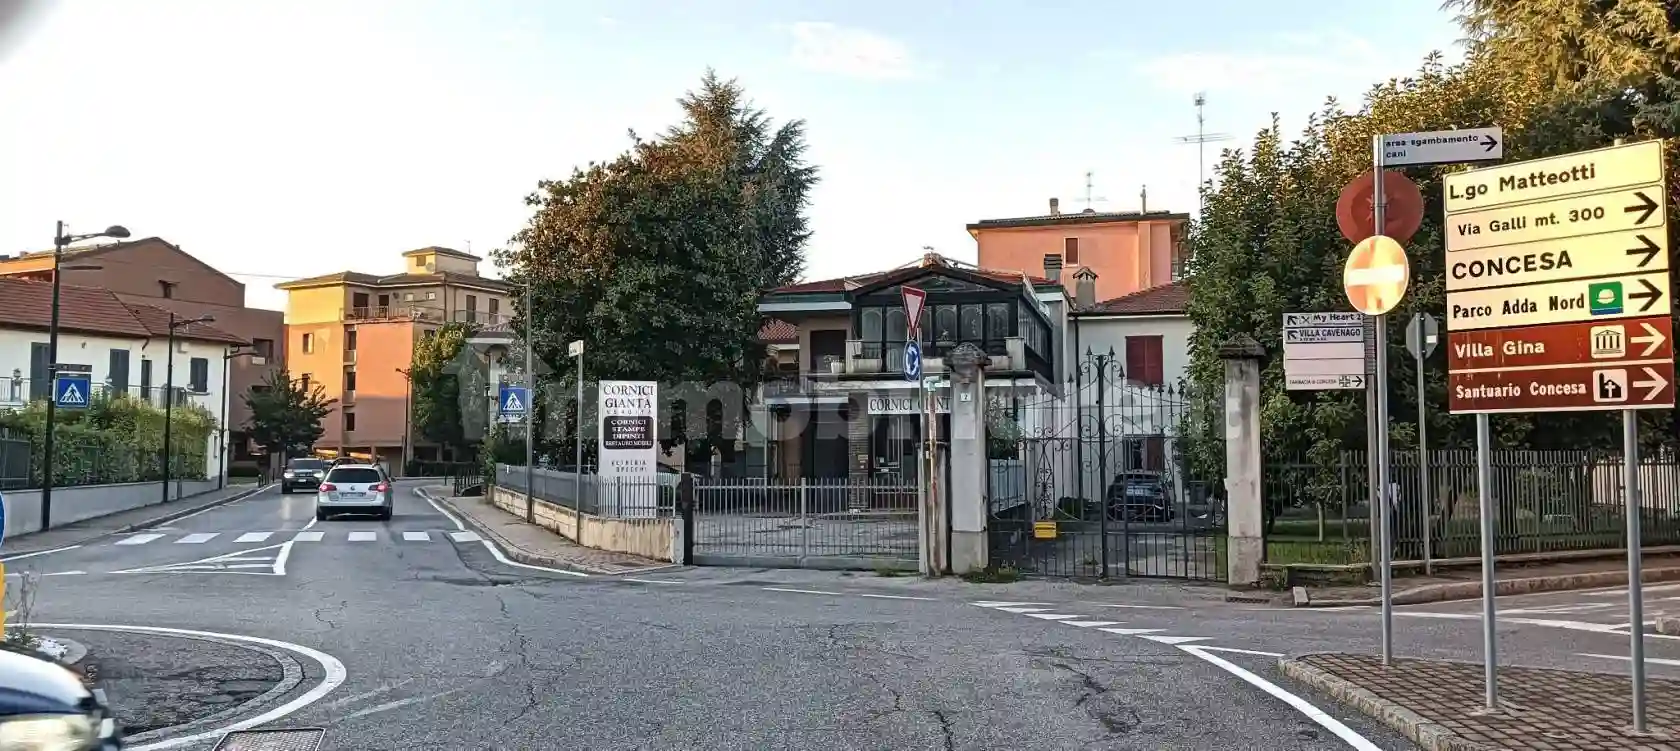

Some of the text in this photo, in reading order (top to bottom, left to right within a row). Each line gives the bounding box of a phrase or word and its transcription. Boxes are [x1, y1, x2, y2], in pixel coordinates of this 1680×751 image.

[1385, 134, 1479, 148] area sgambamento
[1386, 149, 1407, 158] cani
[1450, 163, 1596, 200] L.go Matteotti
[1458, 206, 1605, 236] Via Galli mt. 300
[1452, 250, 1573, 280] CONCESA
[1453, 293, 1585, 319] Parco Adda Nord
[1313, 313, 1327, 323] My
[1330, 313, 1354, 321] Heart
[1300, 328, 1360, 337] VILLA CAVENAGO
[1454, 339, 1545, 358] Villa Gina
[604, 385, 653, 395] CORNICI
[1455, 381, 1587, 399] Santuario Concesa
[605, 398, 651, 408] GIANTA
[870, 398, 913, 411] CORNICI
